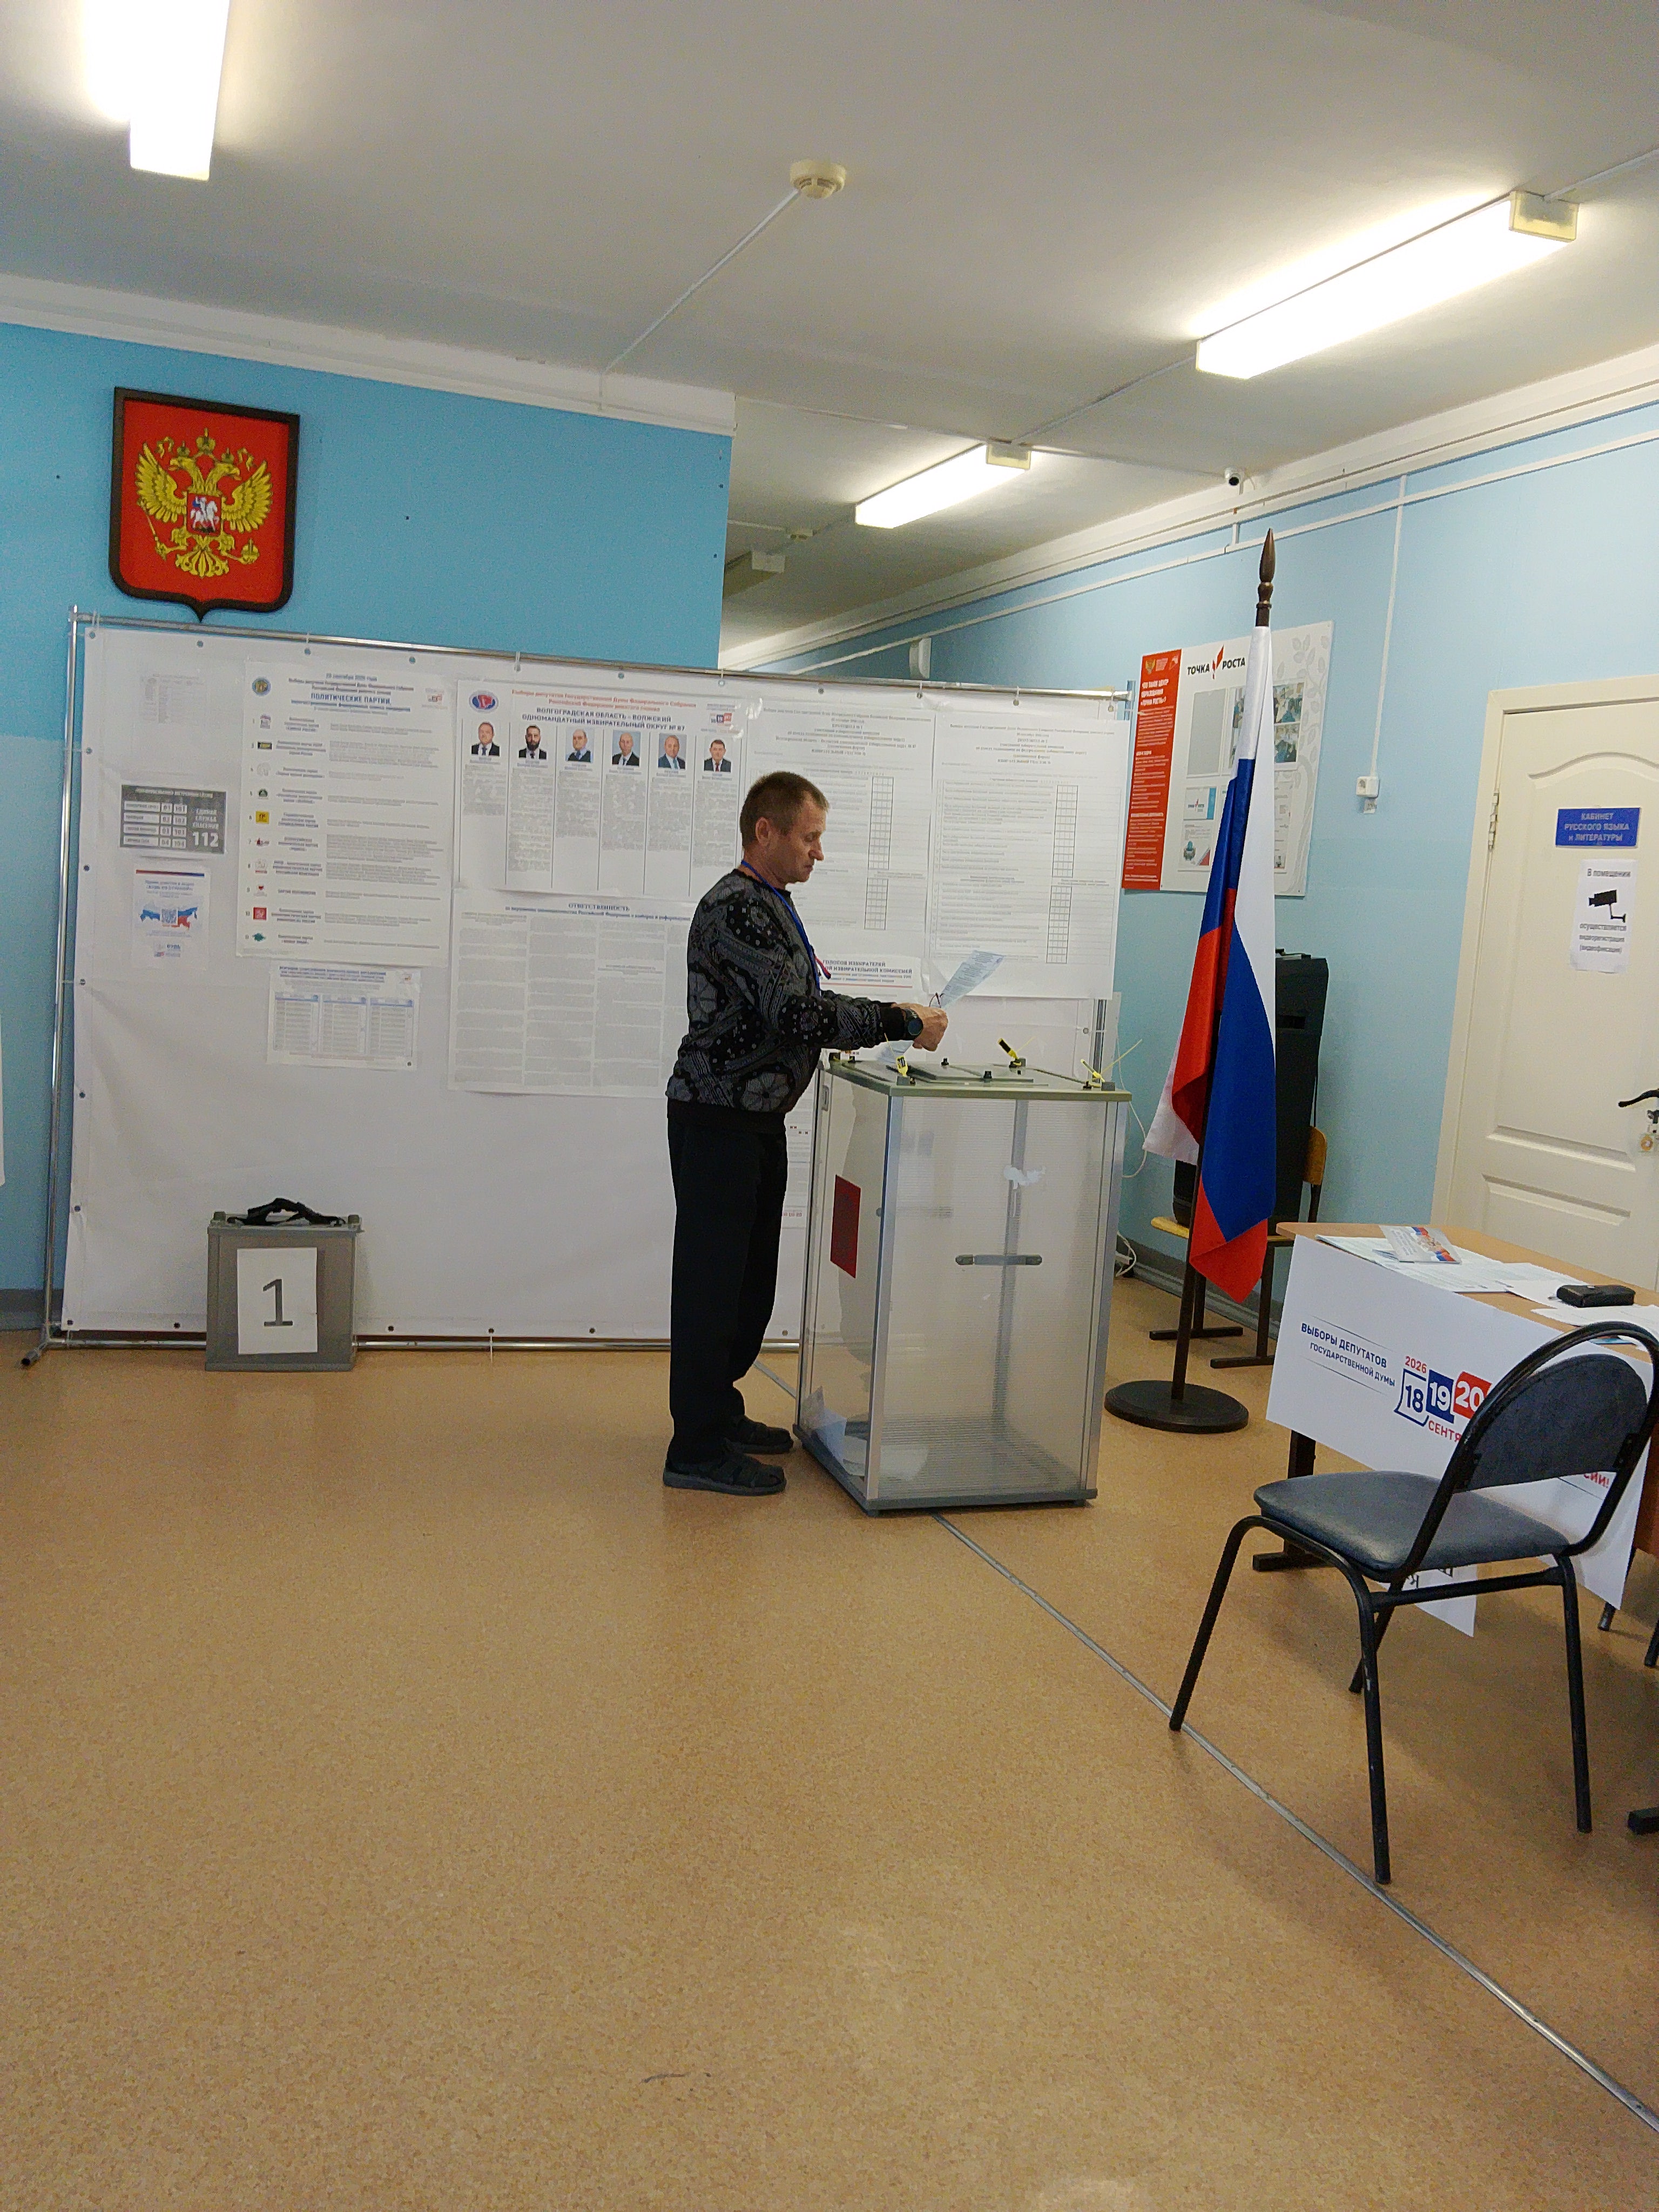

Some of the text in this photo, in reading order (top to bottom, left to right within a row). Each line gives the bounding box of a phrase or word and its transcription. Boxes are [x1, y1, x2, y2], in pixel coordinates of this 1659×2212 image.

[1188, 657, 1245, 675] ТОЧКА РОСТА
[522, 713, 585, 724] ОДНОМАНДАТНЫЙ
[586, 719, 645, 728] ИЗБИРАТЕЛЬНЫЙ
[537, 707, 594, 717] ВОЛГОГРАДСКАЯ
[596, 711, 626, 720] ОБЛАСТЬ
[632, 714, 671, 723] ВОЛЖСКИЙ
[192, 831, 219, 847] 112
[1587, 868, 1591, 876] В
[263, 1279, 293, 1326] 1
[1301, 1323, 1387, 1368] ВЫБОРЫ ДЕПУТАТОВ
[1310, 1342, 1395, 1387] ГОСУДАРСТВЕННОЙ ДУМЫ
[1405, 1356, 1427, 1374] 2026
[1405, 1380, 1485, 1413] 18 19 20
[1428, 1420, 1462, 1442] СЕНТЯ
